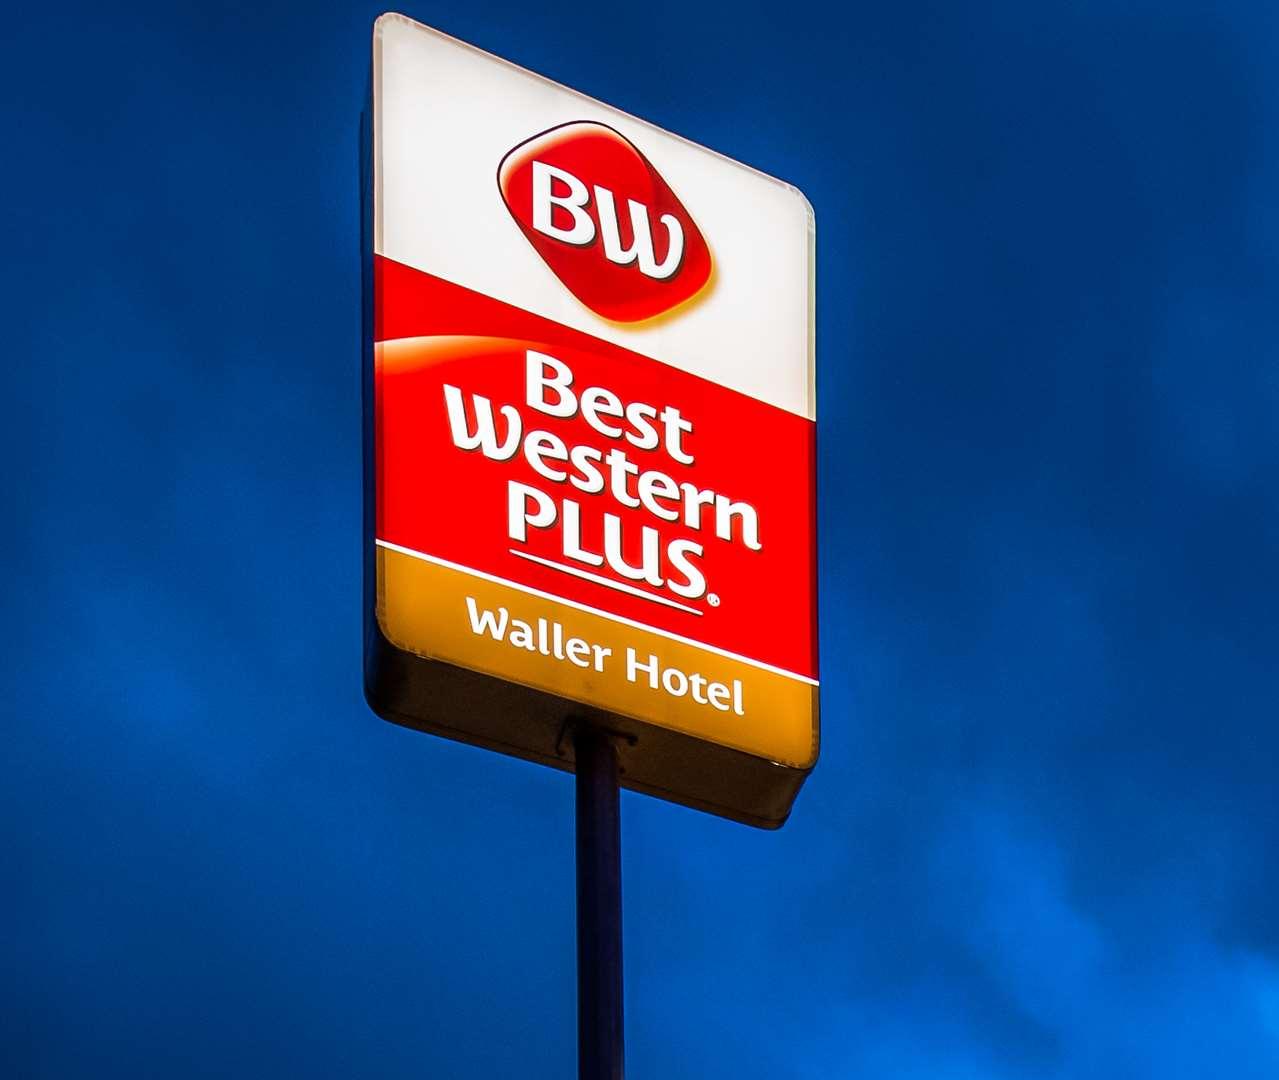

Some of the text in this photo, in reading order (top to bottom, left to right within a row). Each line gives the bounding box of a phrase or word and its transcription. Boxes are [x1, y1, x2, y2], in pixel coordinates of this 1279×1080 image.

[532, 160, 684, 279] BW
[526, 349, 694, 465] Best
[443, 383, 762, 550] Western
[508, 480, 707, 598] PLUS
[466, 597, 745, 715] Waller Hotel
